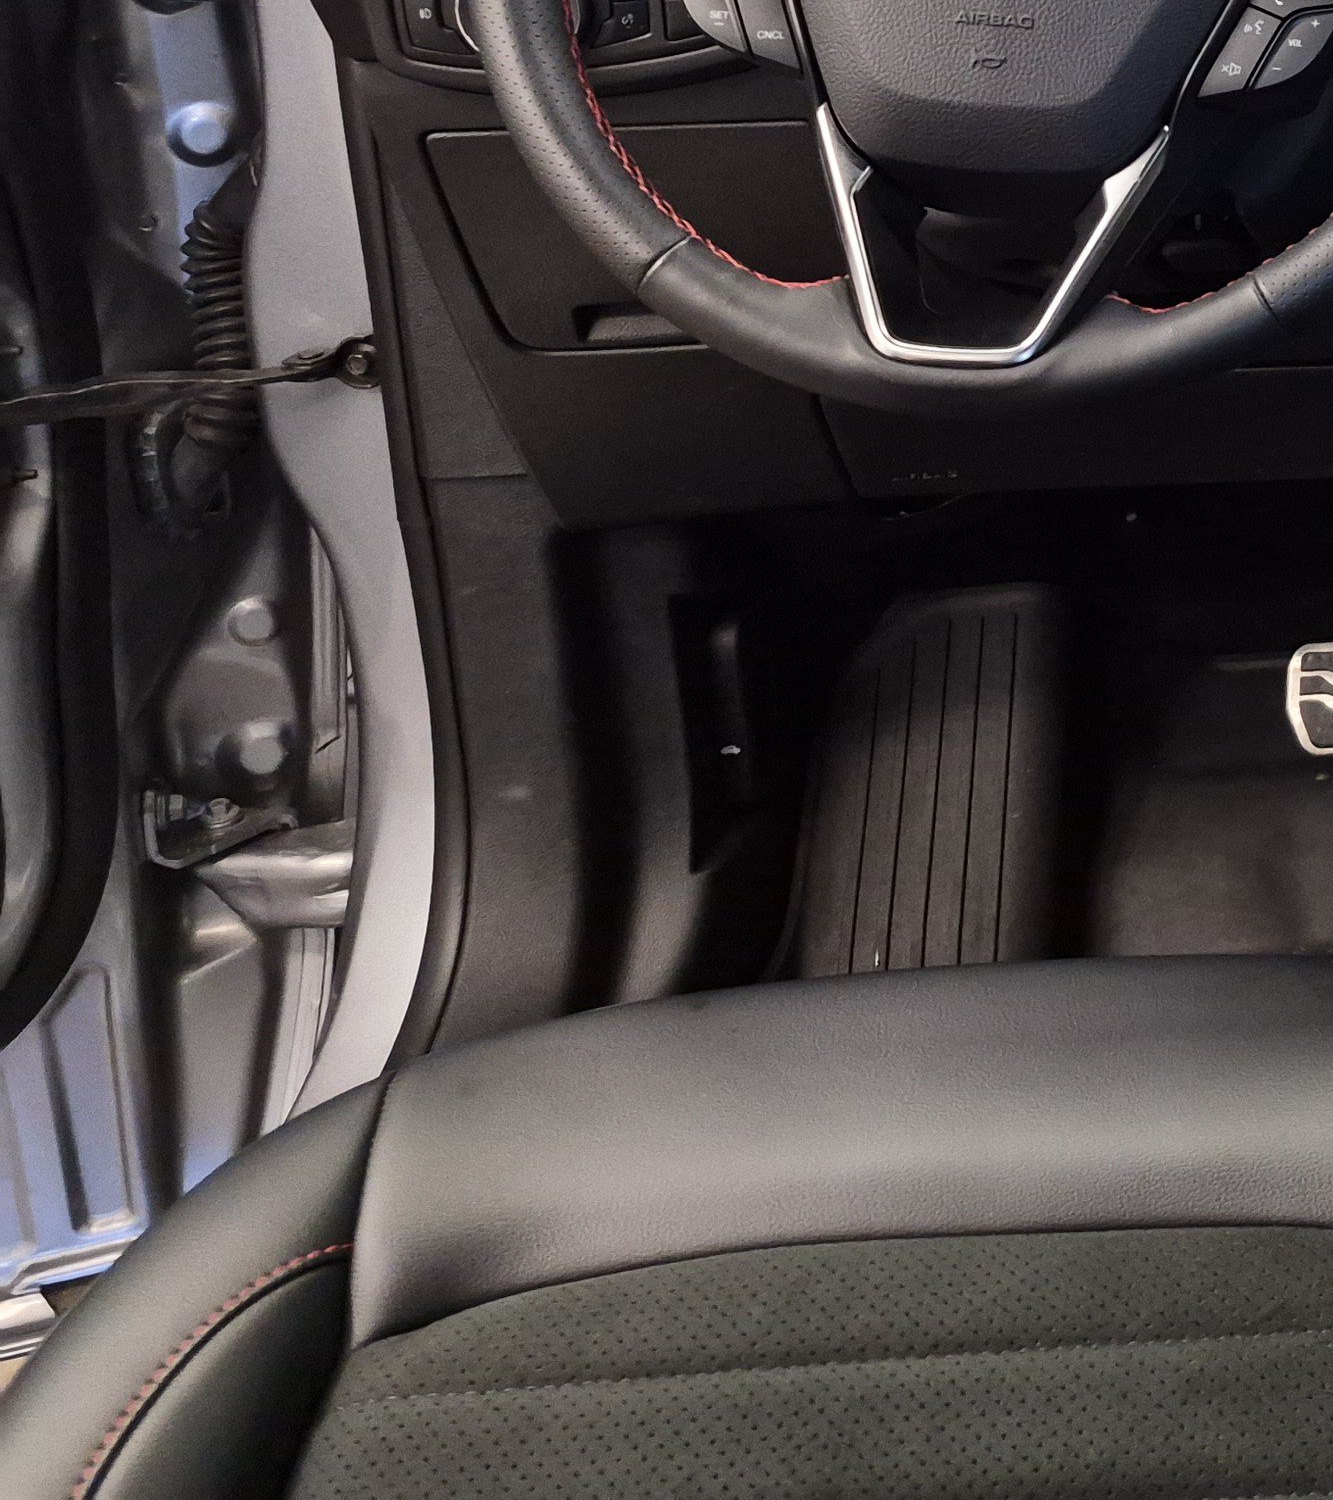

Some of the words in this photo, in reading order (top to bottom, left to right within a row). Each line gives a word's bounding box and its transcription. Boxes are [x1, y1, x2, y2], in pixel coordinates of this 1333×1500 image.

[709, 10, 729, 19] SET
[955, 10, 1034, 30] AIRBAG
[757, 30, 785, 39] CNCL
[1288, 39, 1302, 48] VOL
